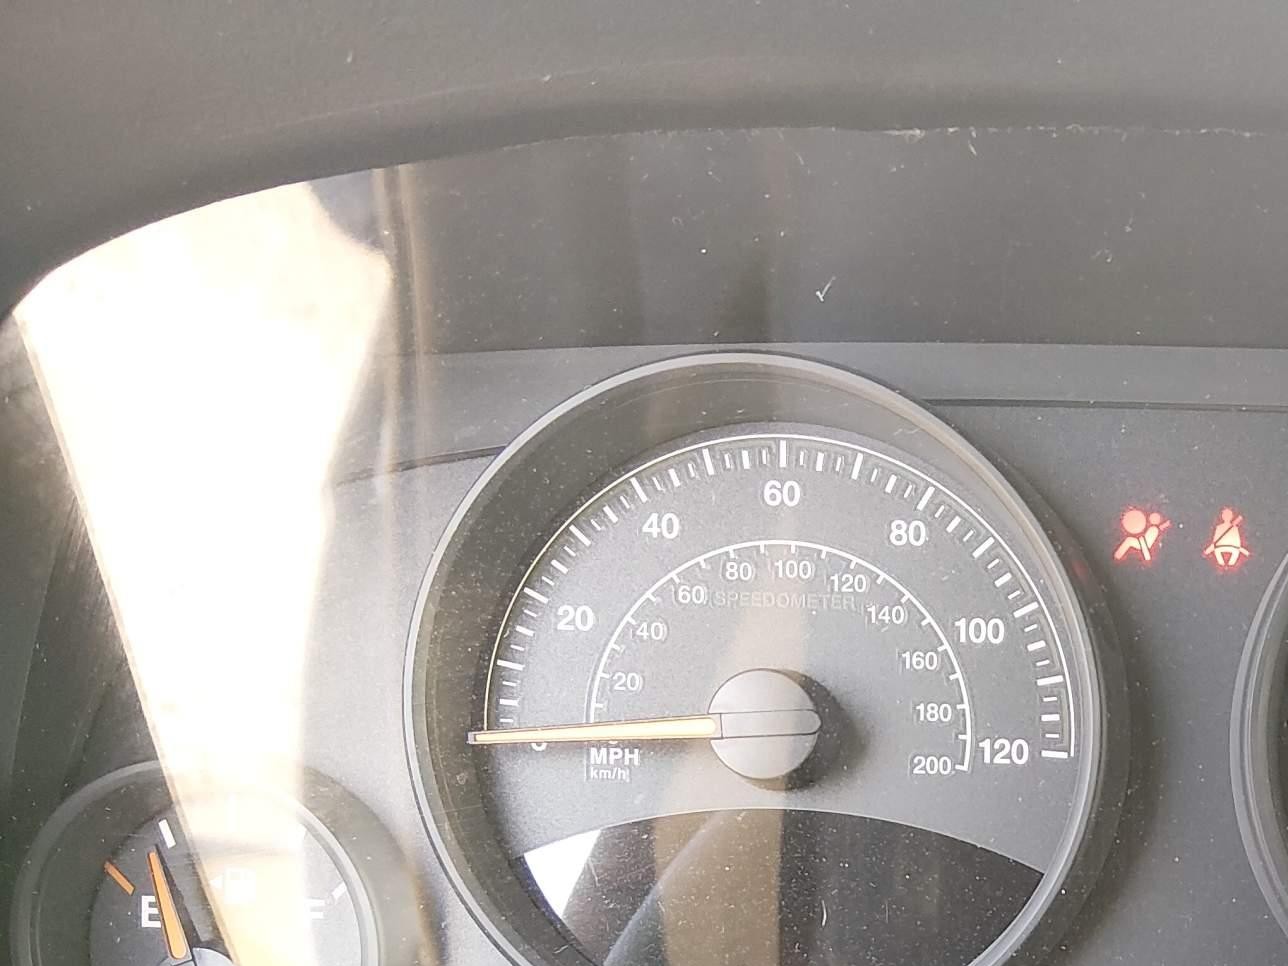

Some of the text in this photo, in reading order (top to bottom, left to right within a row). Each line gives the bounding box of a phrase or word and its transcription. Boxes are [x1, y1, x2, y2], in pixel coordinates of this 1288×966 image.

[763, 481, 800, 506] 60
[642, 513, 679, 539] 40
[889, 520, 926, 546] 80
[725, 562, 752, 580] 80
[776, 561, 812, 579] 100
[831, 574, 867, 592] 120
[677, 585, 705, 604] 60
[715, 593, 855, 608] SPEEDOMETER
[557, 605, 594, 631] 20
[868, 605, 904, 624] 140
[636, 622, 664, 640] 40
[956, 618, 1004, 644] 100
[902, 652, 937, 670] 160
[613, 673, 639, 691] 20
[916, 703, 951, 722] 180
[590, 748, 639, 765] MPH
[978, 739, 1028, 765] 120
[590, 768, 626, 780] km/h
[913, 756, 951, 775] 200
